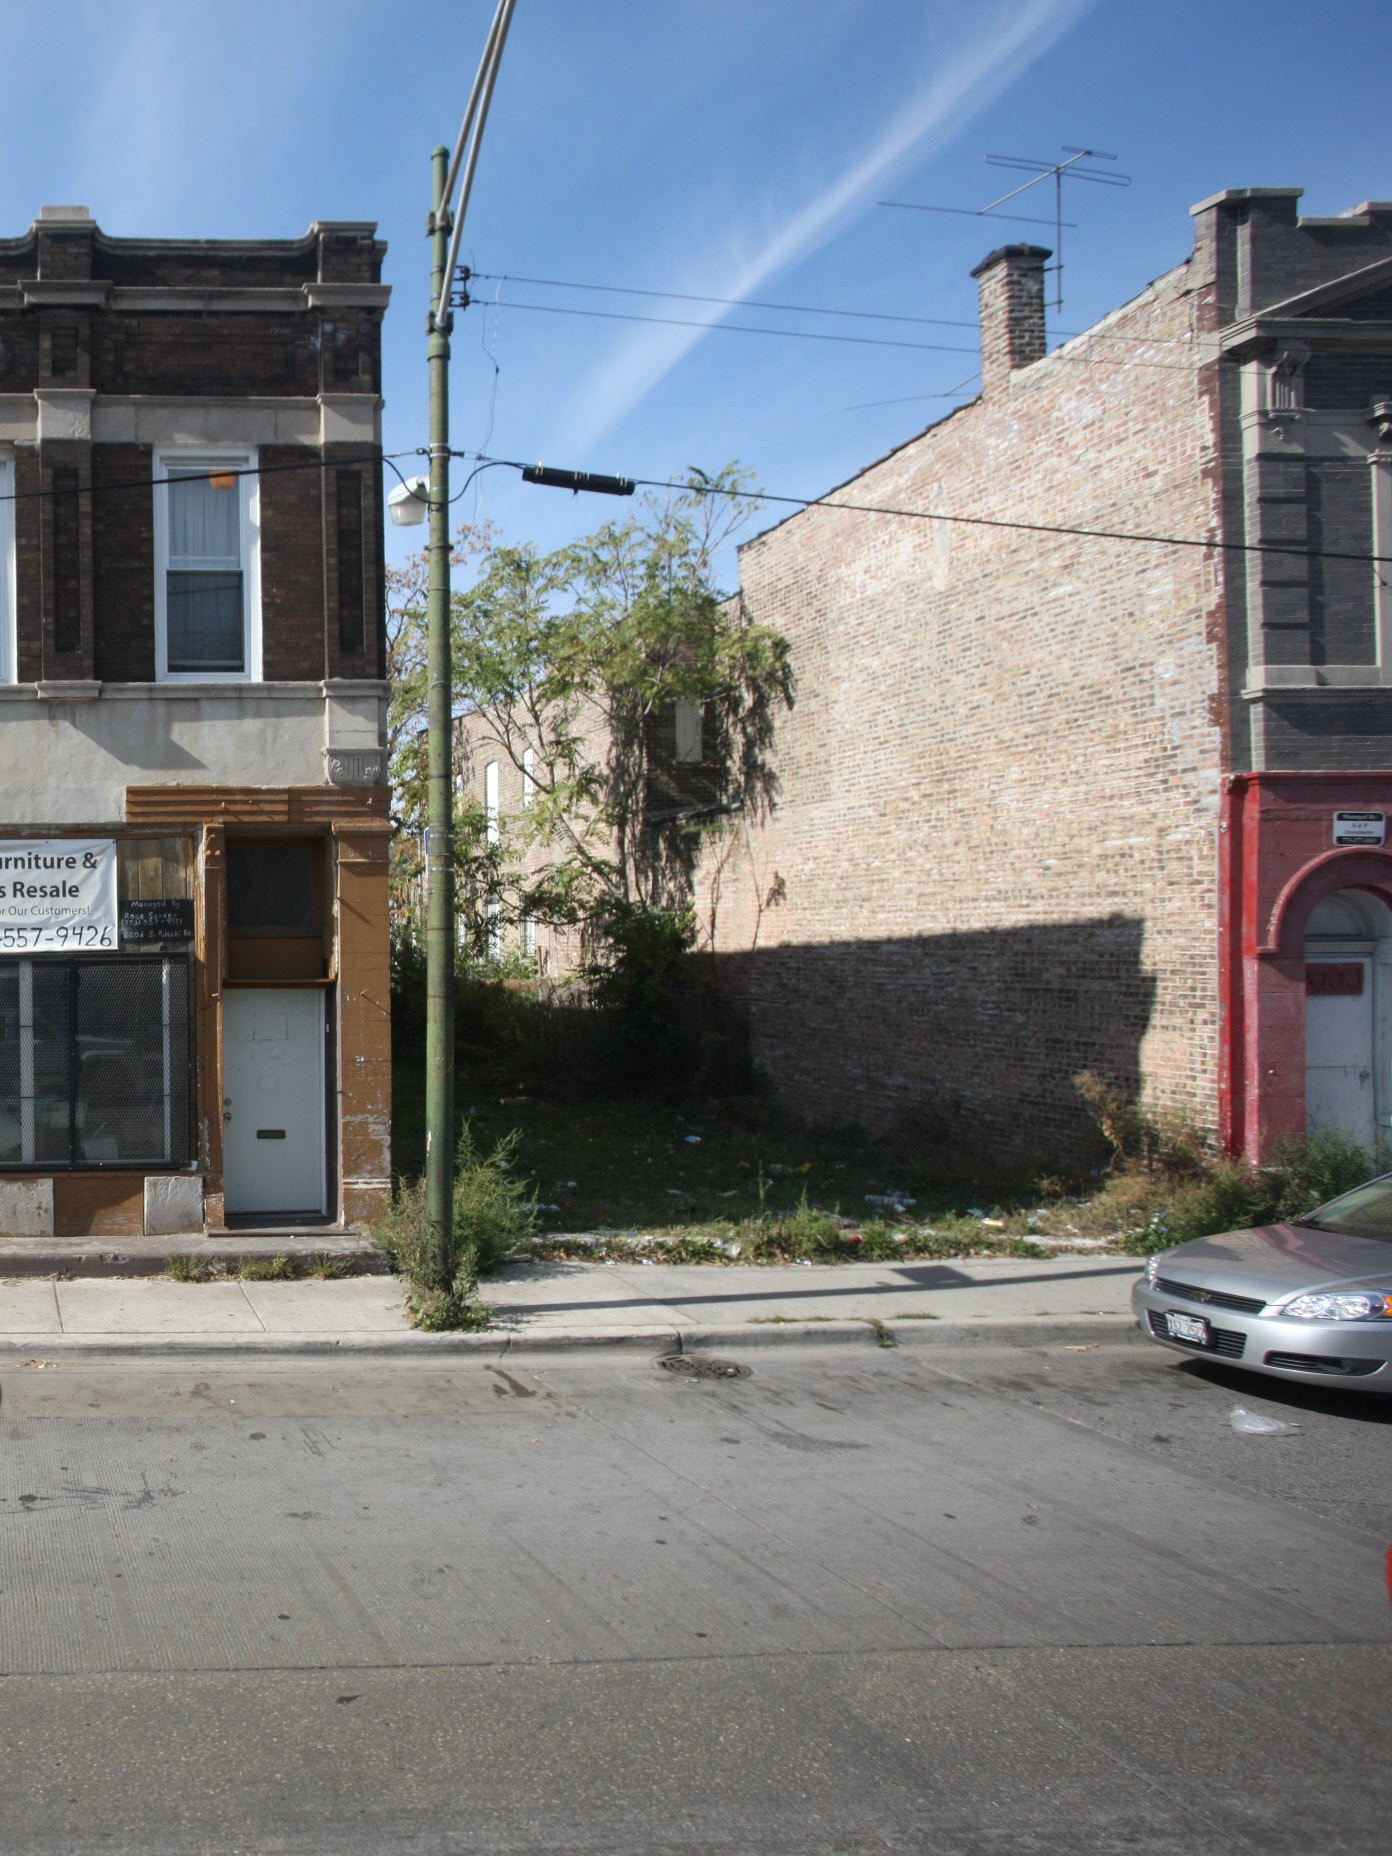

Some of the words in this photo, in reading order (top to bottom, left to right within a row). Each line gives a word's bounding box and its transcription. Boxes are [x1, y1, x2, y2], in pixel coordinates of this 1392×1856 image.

[82, 852, 98, 870] &
[12, 881, 80, 899] Resale
[8, 906, 28, 917] Our
[30, 906, 90, 917] Customers!
